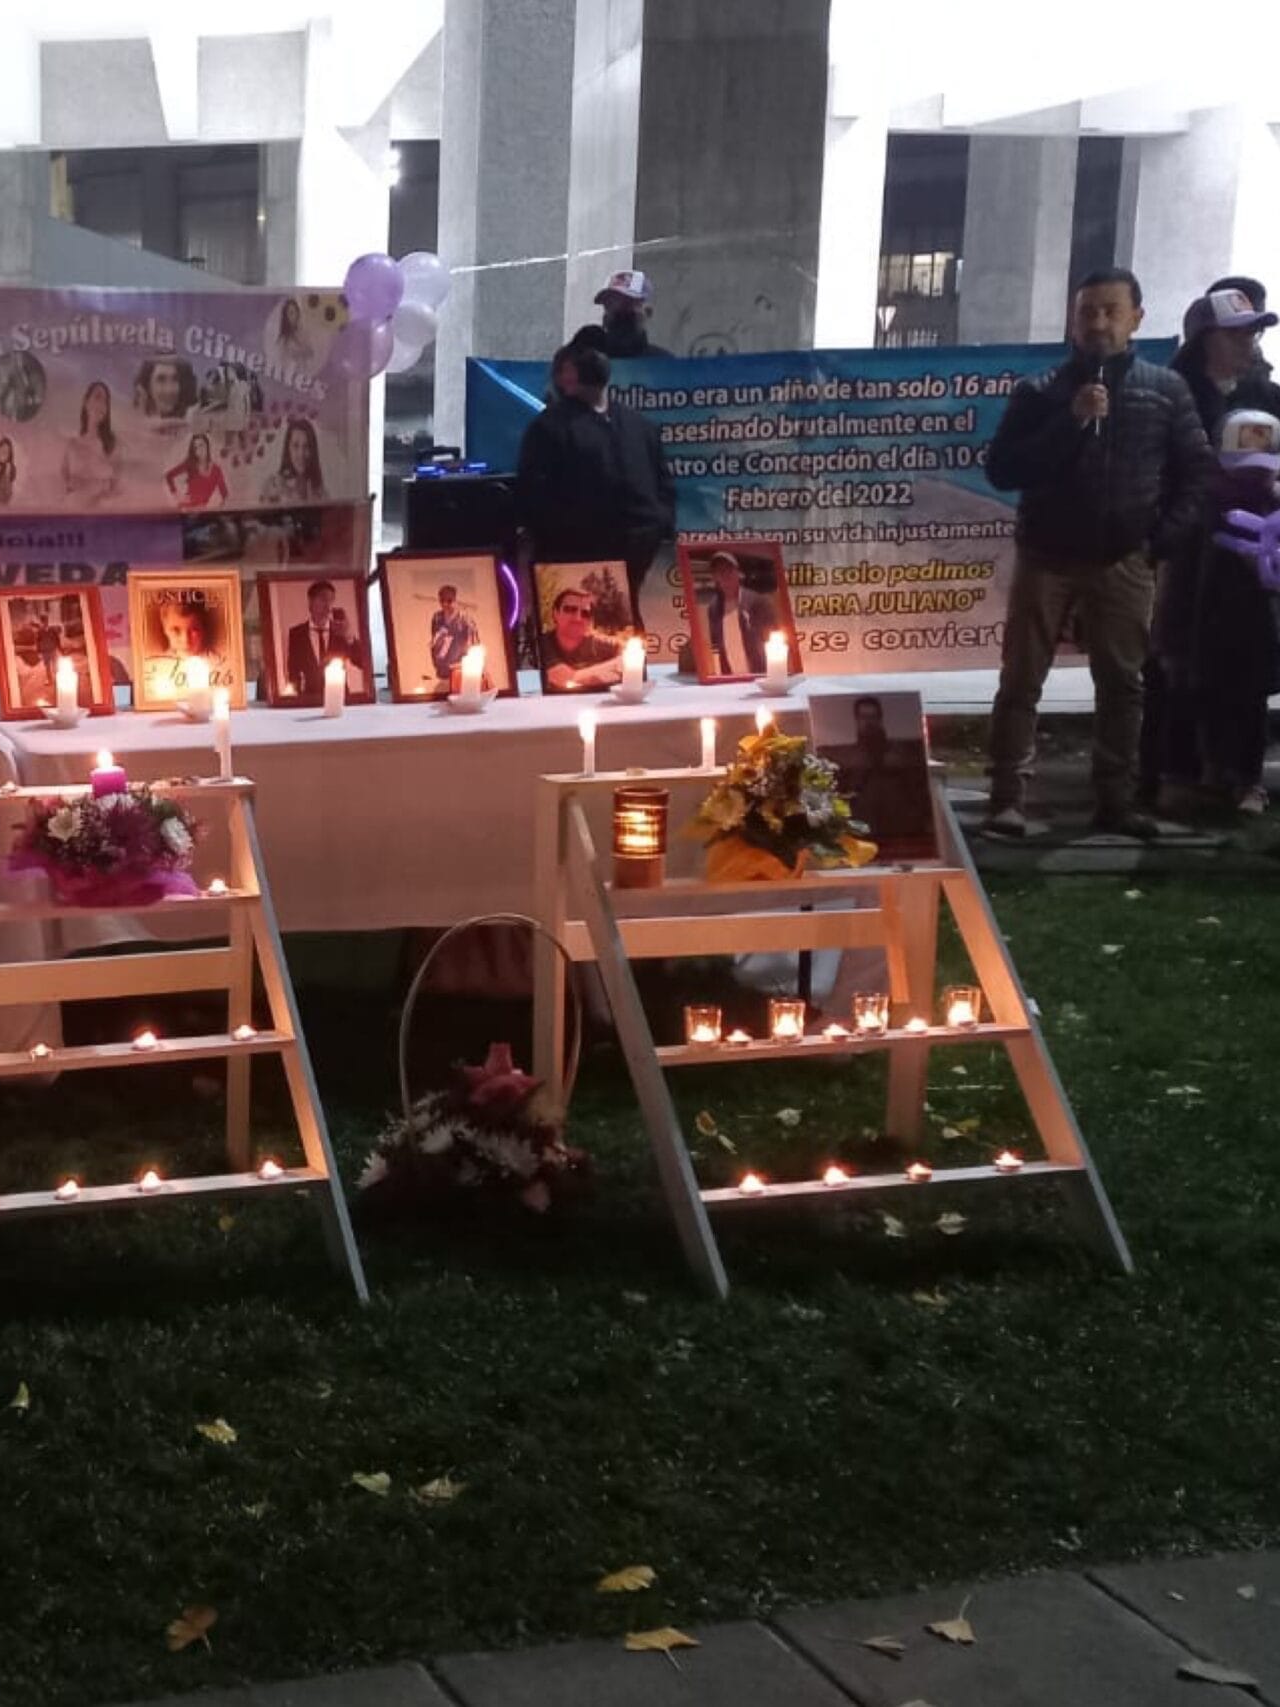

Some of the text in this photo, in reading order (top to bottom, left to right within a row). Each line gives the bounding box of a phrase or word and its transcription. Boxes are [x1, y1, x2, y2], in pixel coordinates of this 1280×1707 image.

[11, 314, 174, 352] Sepúlveda
[185, 324, 329, 400] Cifuentes
[692, 387, 728, 405] era
[734, 386, 763, 404] un
[770, 377, 818, 403] niño
[823, 375, 851, 399] de
[857, 379, 891, 398] tan
[896, 374, 945, 398] solo
[952, 374, 979, 396] 16
[983, 371, 1019, 396] añ
[661, 408, 974, 443] asesinado brutalmente en el
[711, 453, 740, 474] de
[745, 449, 872, 477] Concepción
[877, 446, 897, 469] el
[902, 445, 938, 468] día
[946, 446, 971, 467] 10
[727, 483, 912, 510] Febrero del 2022
[802, 530, 825, 544] su
[830, 523, 871, 542] vida
[878, 520, 1016, 545] injustamente
[832, 561, 884, 584] solo
[889, 559, 994, 587] pedimos
[796, 589, 986, 617] PARA JULIANO"
[811, 630, 849, 651] se
[863, 620, 1005, 650] conviert
